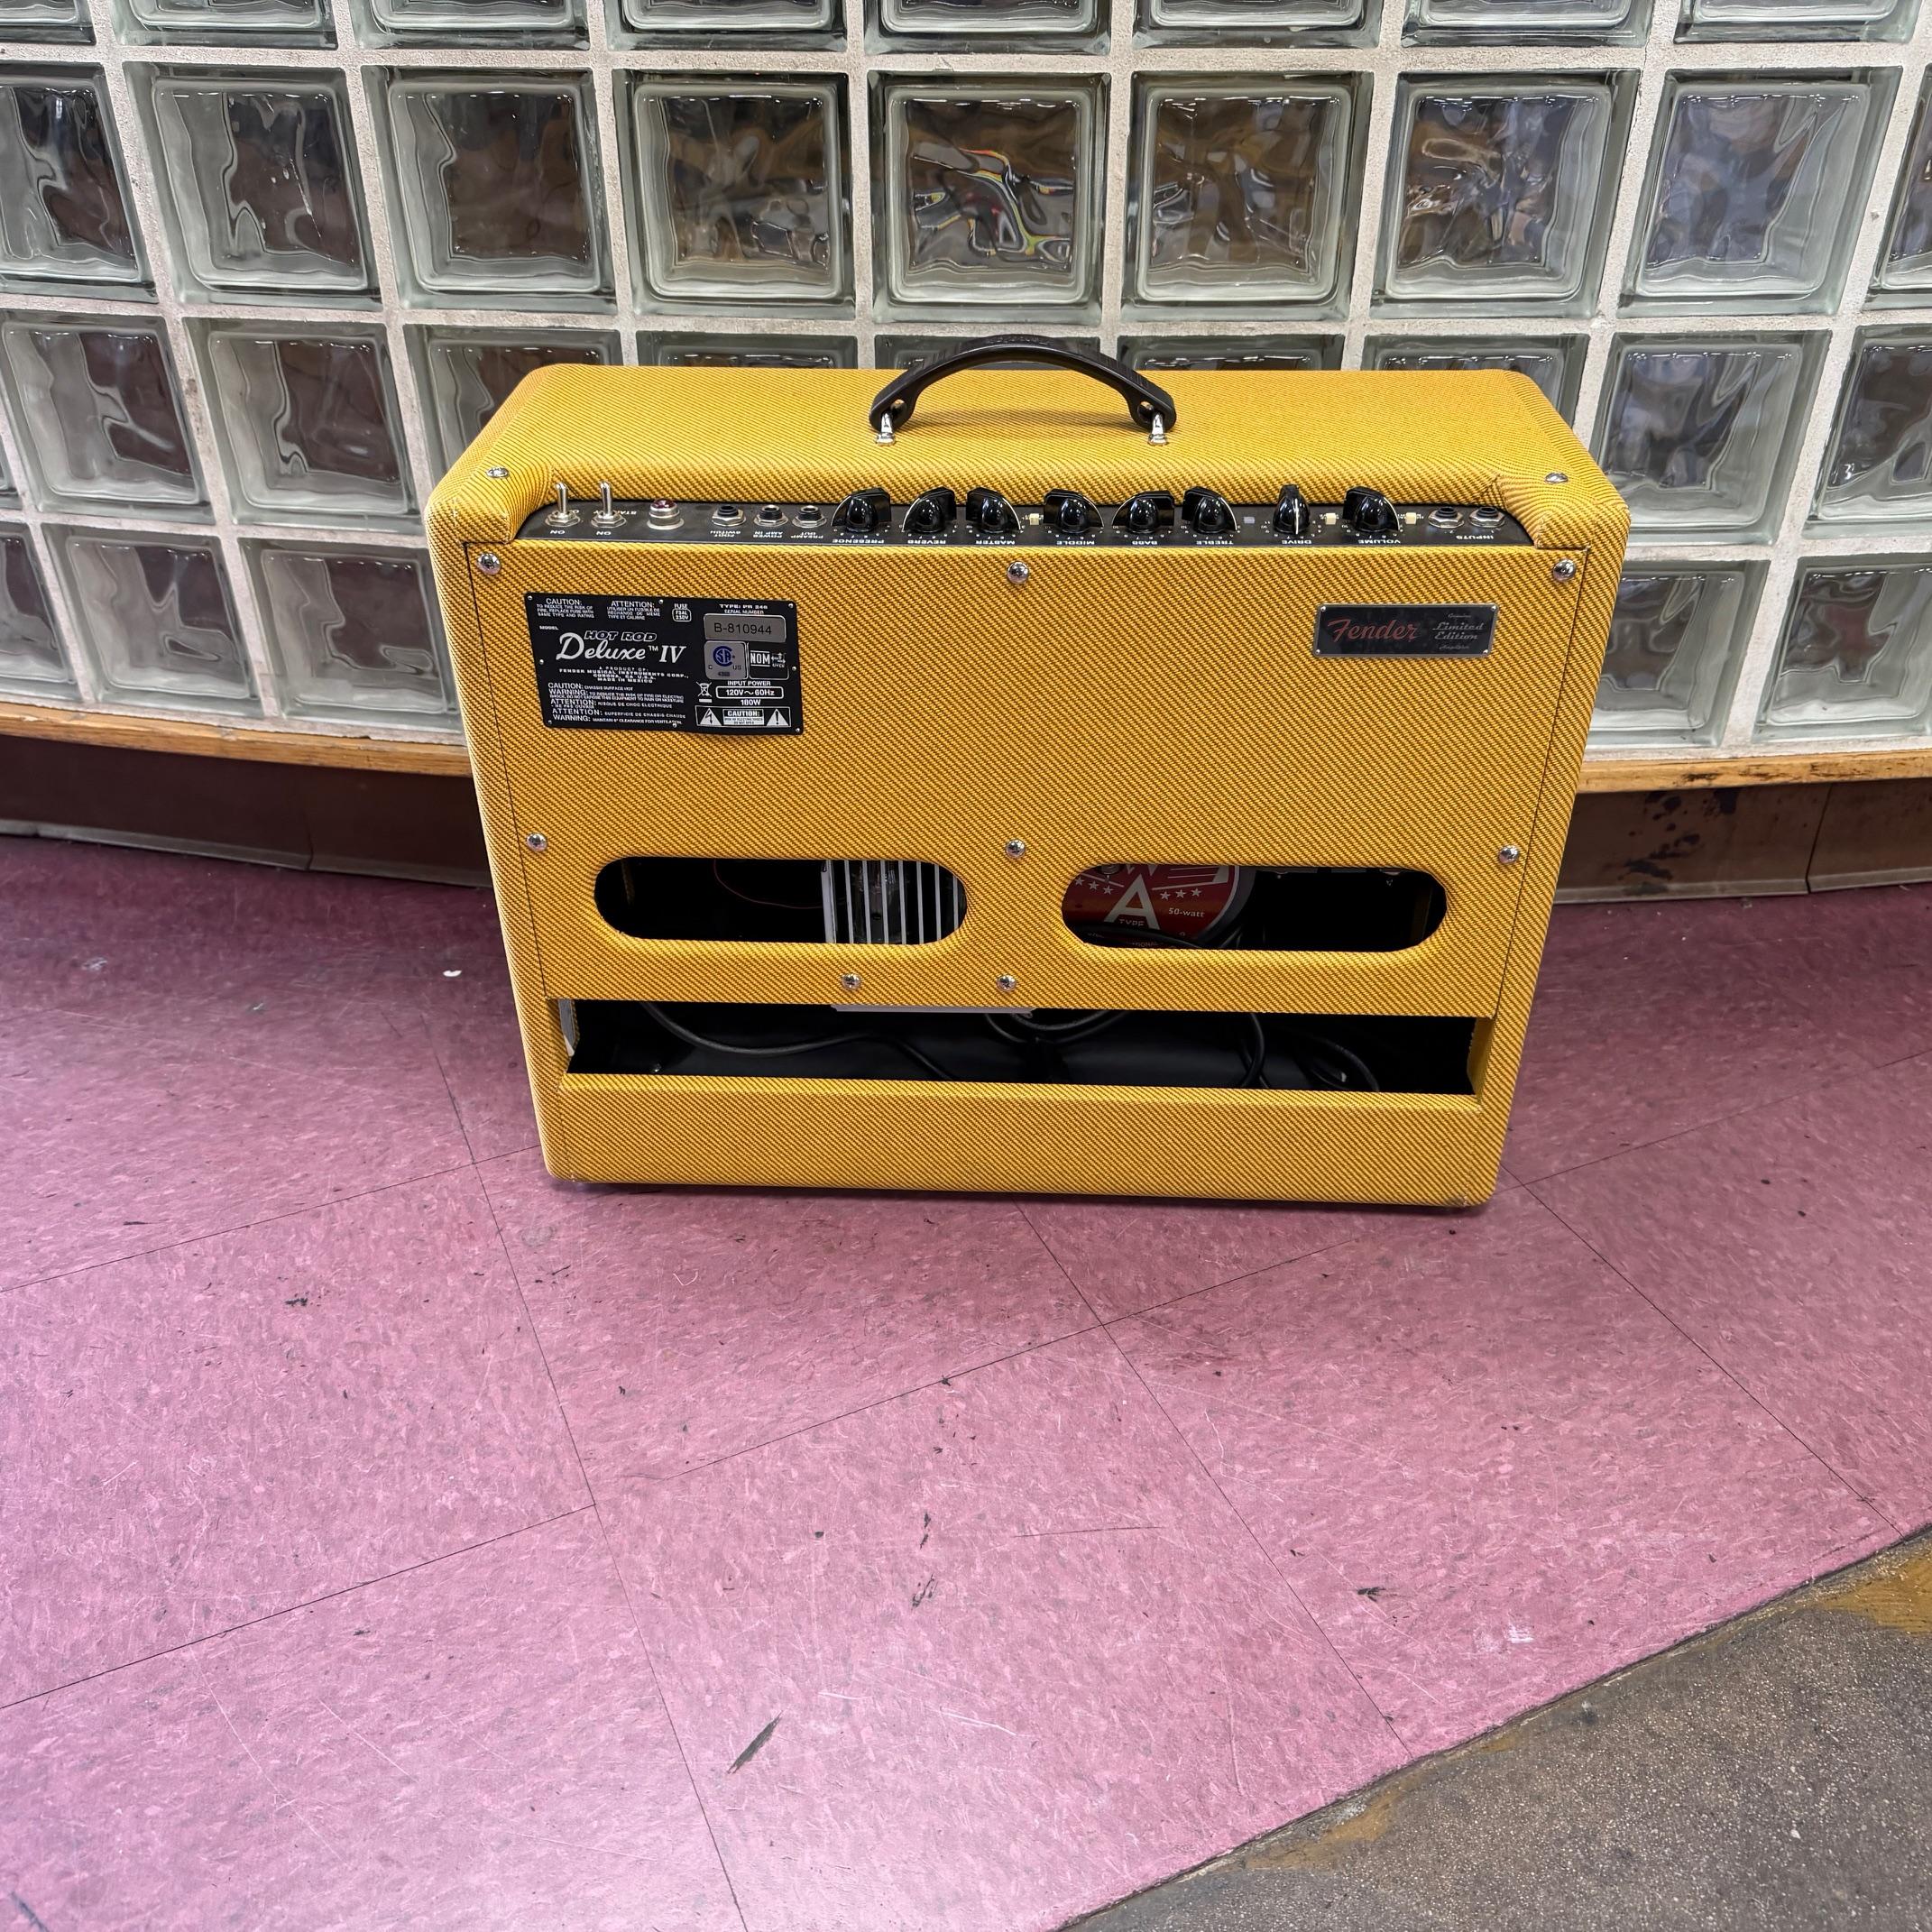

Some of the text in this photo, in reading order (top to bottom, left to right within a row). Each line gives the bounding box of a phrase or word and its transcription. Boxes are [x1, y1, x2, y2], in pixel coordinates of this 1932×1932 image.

[714, 622, 772, 635] B-810944
[1327, 616, 1418, 642] Fender
[584, 630, 657, 641] HOT ROD
[556, 632, 646, 660] Deluxe
[659, 645, 686, 663] IV
[750, 653, 770, 664] NOM
[1103, 874, 1161, 930] A
[1169, 907, 1205, 917] 50-watt
